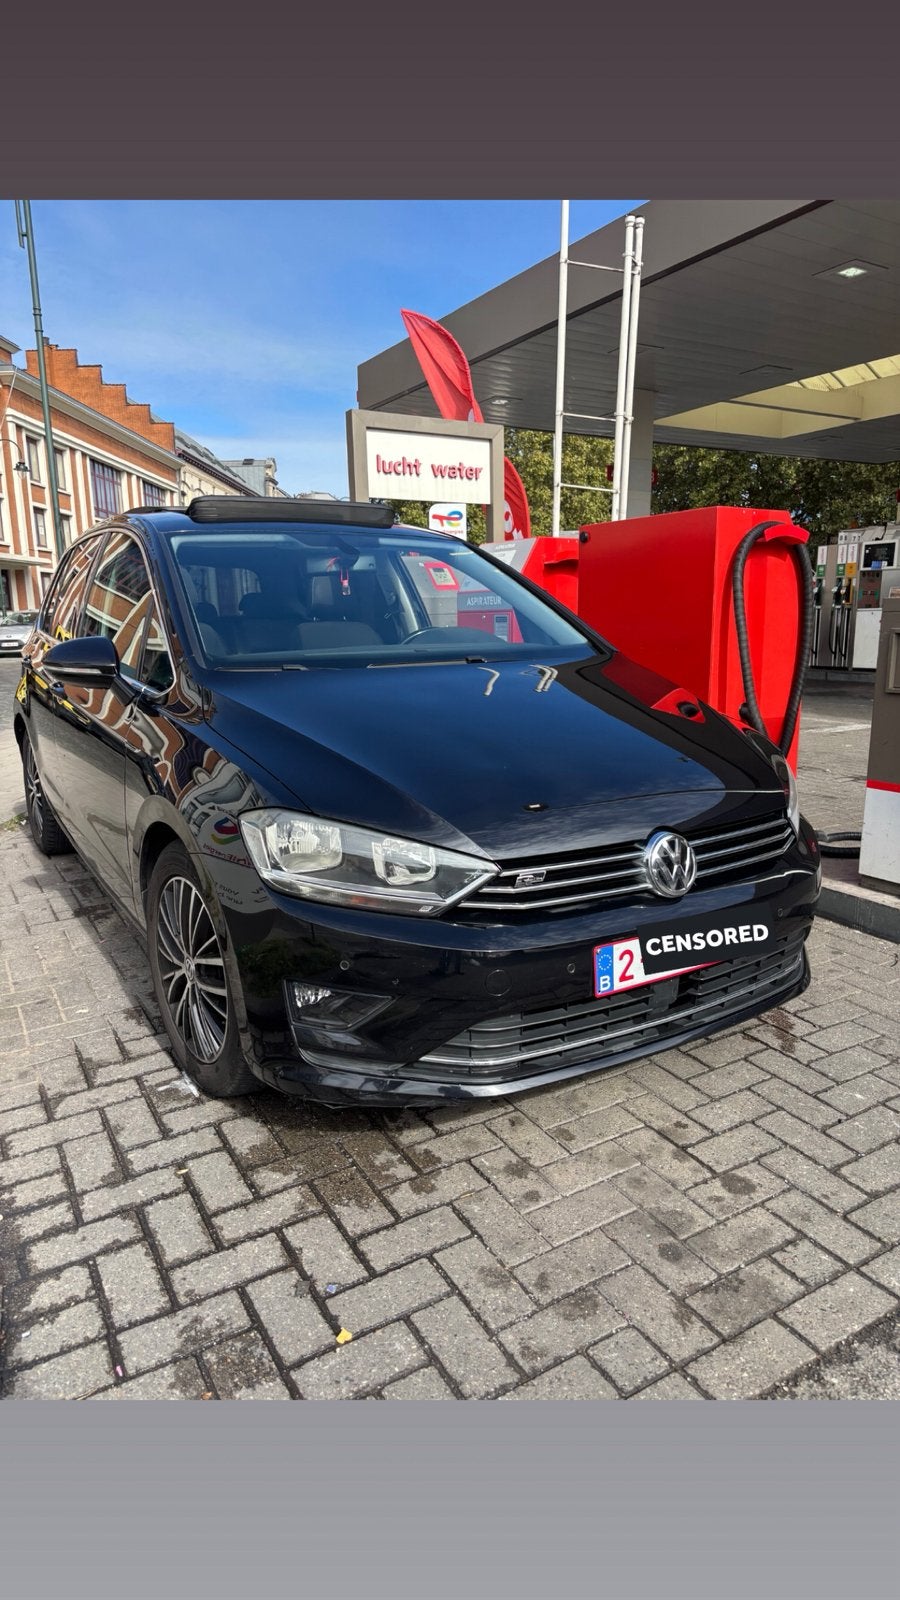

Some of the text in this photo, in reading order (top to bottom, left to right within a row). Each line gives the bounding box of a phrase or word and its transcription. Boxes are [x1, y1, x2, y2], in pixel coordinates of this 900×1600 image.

[376, 454, 483, 481] lucht water
[466, 595, 502, 606] ASPIRATEUR
[599, 975, 611, 991] B
